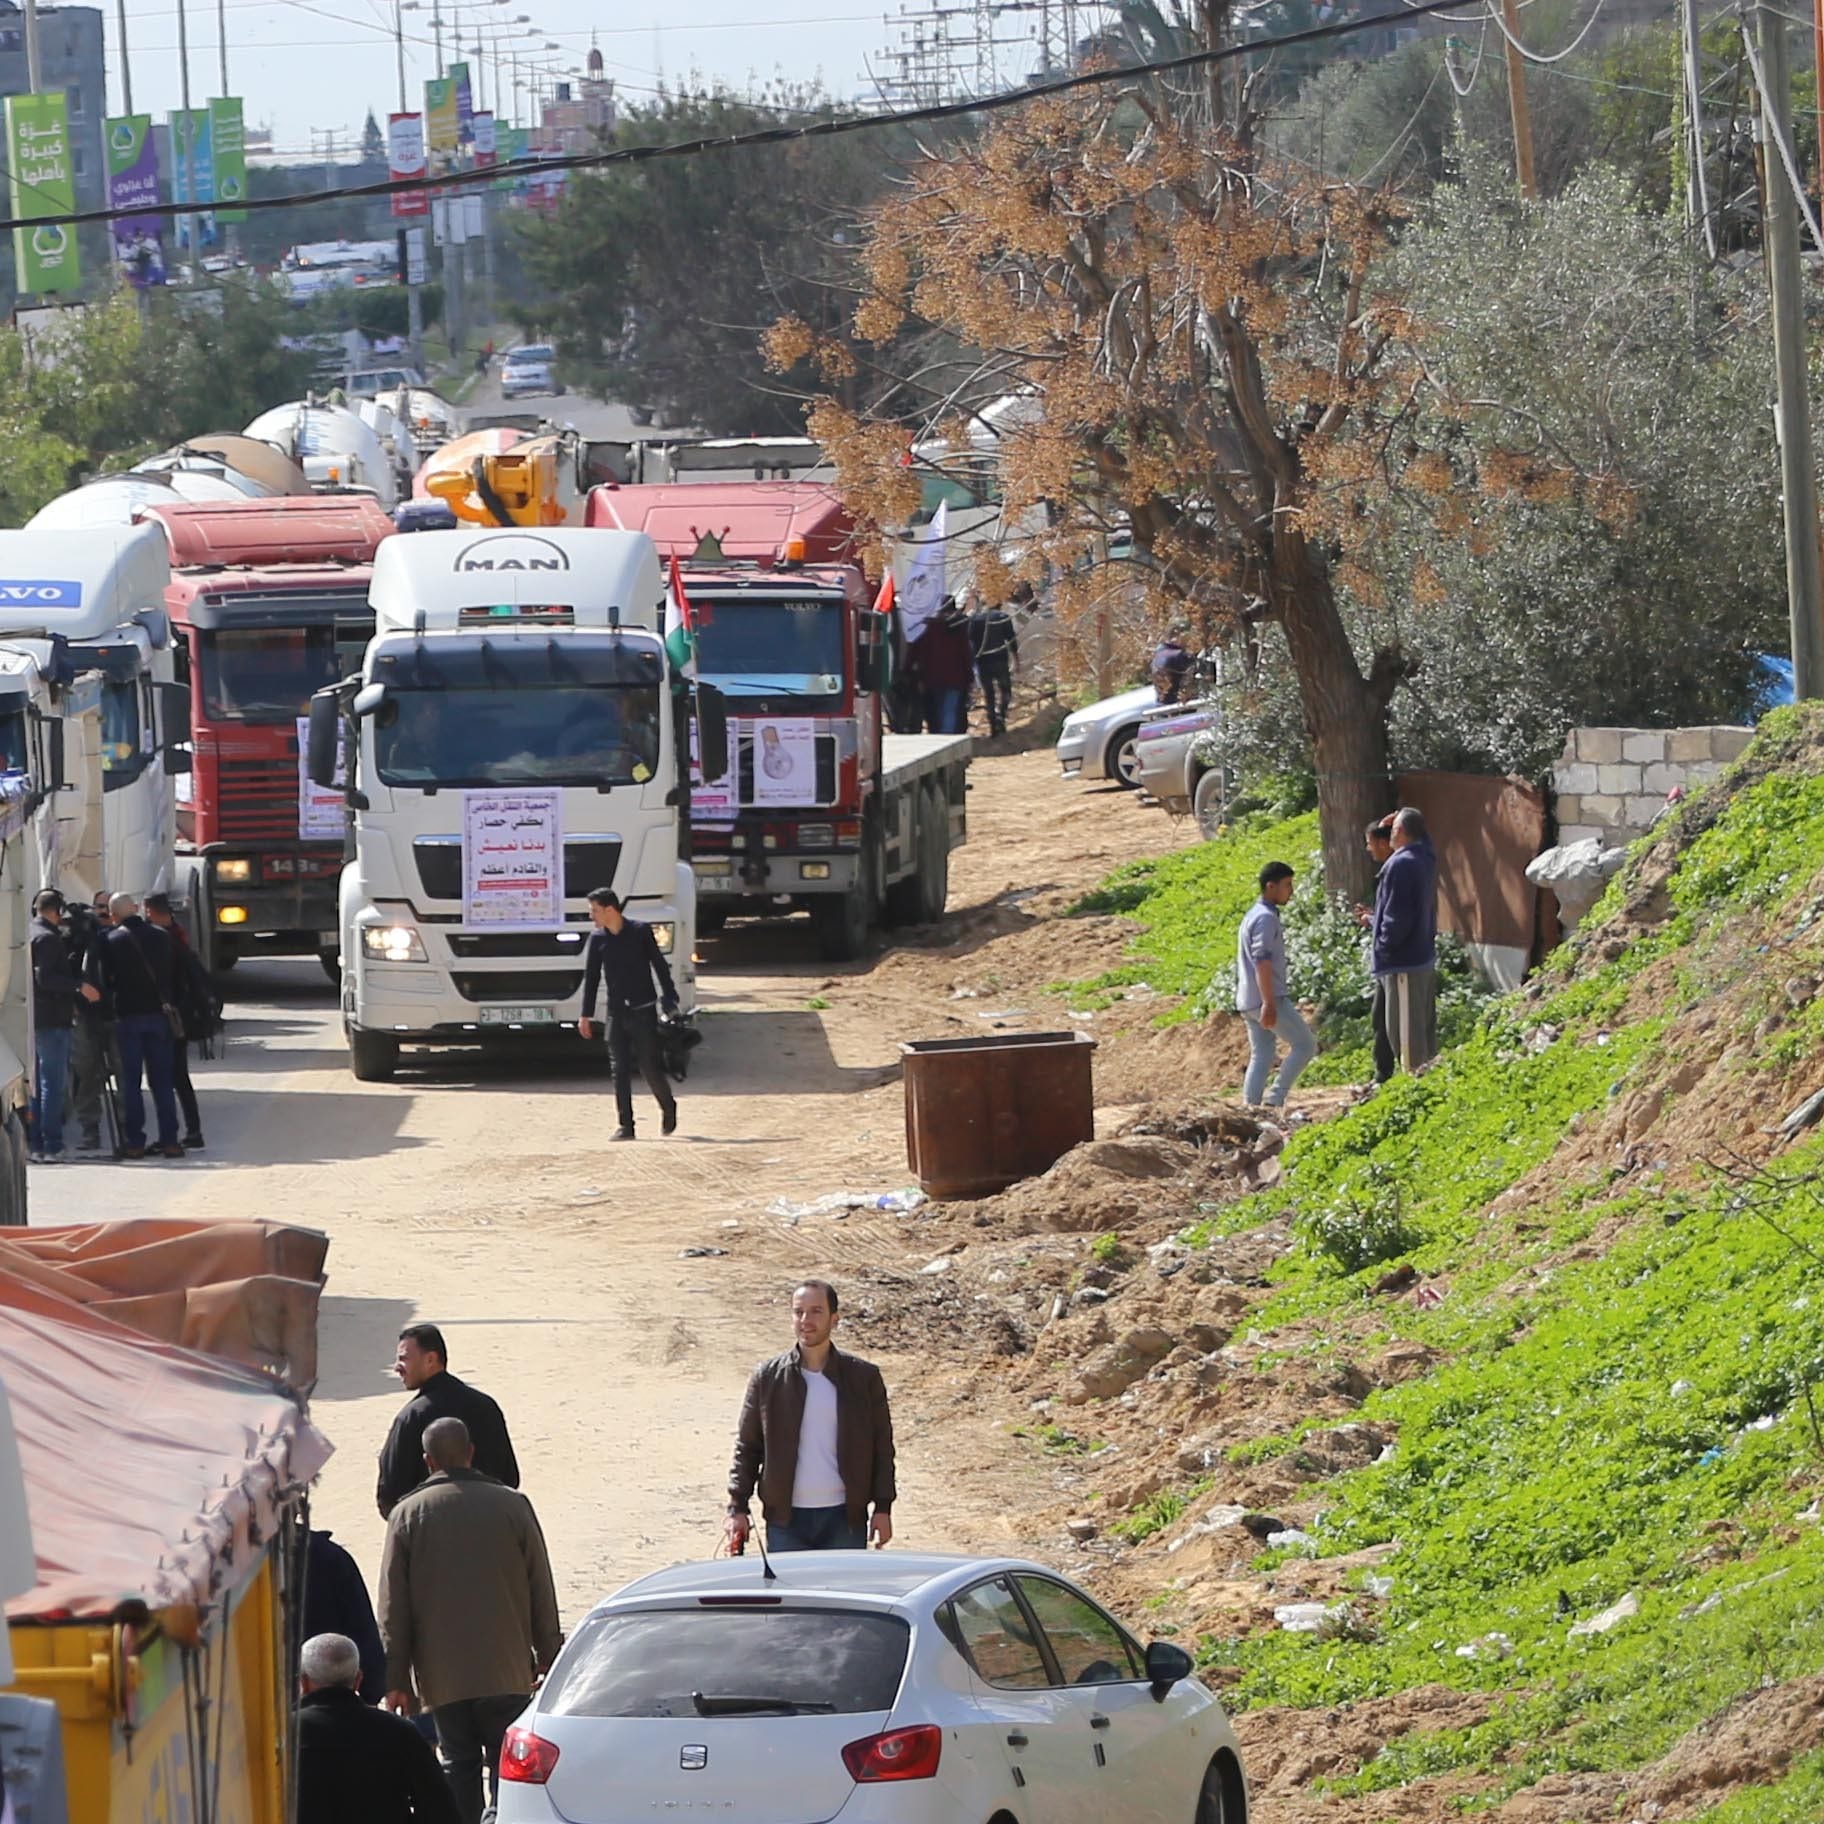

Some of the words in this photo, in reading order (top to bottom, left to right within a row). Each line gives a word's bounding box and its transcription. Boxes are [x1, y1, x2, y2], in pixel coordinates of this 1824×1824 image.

[19, 119, 63, 140] غزة
[20, 139, 65, 160] كبيرة
[21, 158, 66, 186] بأهلها
[464, 559, 560, 571] MAN
